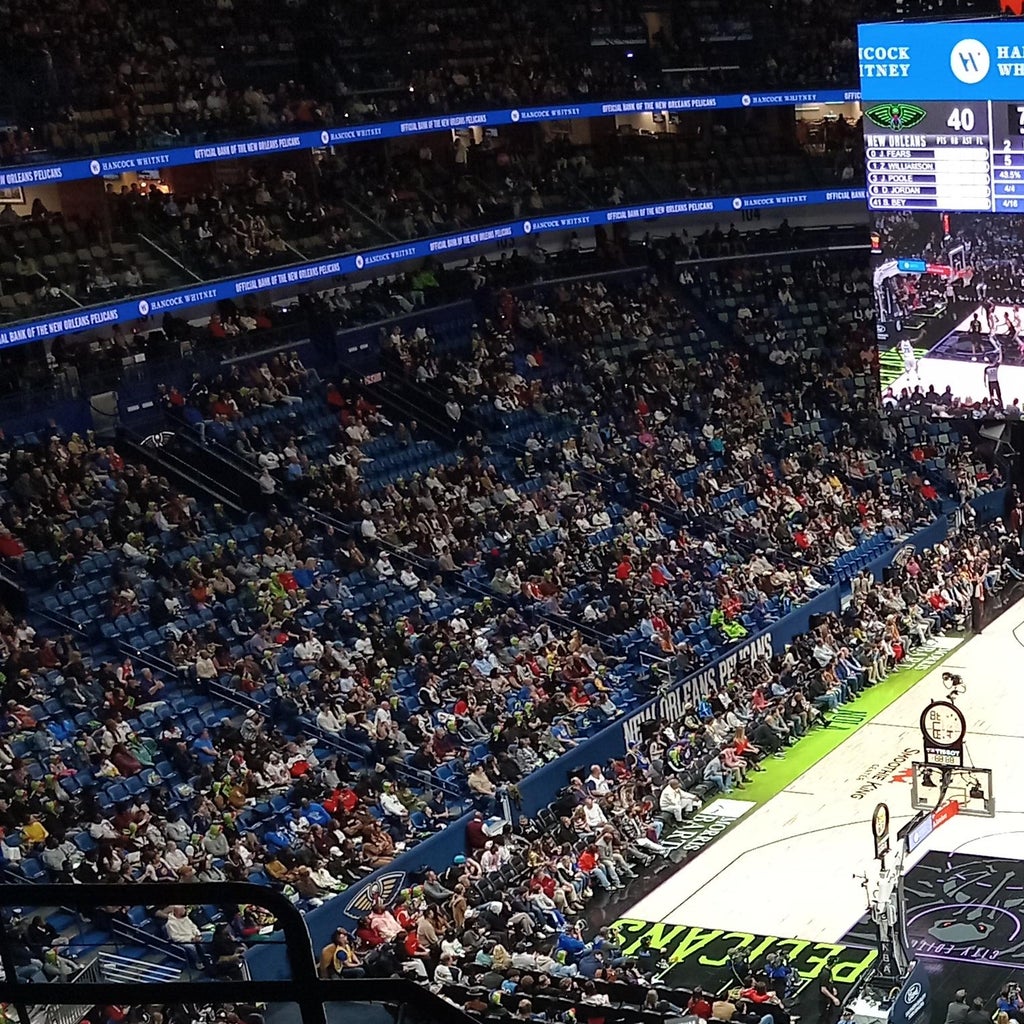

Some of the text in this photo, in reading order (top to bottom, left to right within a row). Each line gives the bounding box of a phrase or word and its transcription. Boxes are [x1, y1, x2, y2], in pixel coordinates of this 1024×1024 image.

[946, 107, 975, 131] 40
[867, 135, 928, 148] NEW ORLEANS
[1003, 139, 1012, 151] 2
[886, 150, 911, 158] FEARS
[1004, 154, 1012, 167] 5
[102, 154, 170, 172] HANCOCK WHITNEY
[6, 167, 63, 186] ORLEANS PELICANS
[888, 174, 913, 182] POOLE
[826, 192, 850, 201] OFFICIAL
[890, 187, 921, 195] JORDAN
[744, 195, 808, 207] HANCOCK WHITNEY
[872, 199, 881, 207] 41
[891, 199, 907, 207] BEY
[151, 289, 218, 311] HANCOCK WHITNEY
[10, 309, 119, 343] BANK OF THE NEW ORLEANS PELICANS
[659, 667, 719, 725] ORLEANS
[850, 747, 920, 800] SMOOTHIE KING
[882, 942, 892, 974] NBA
